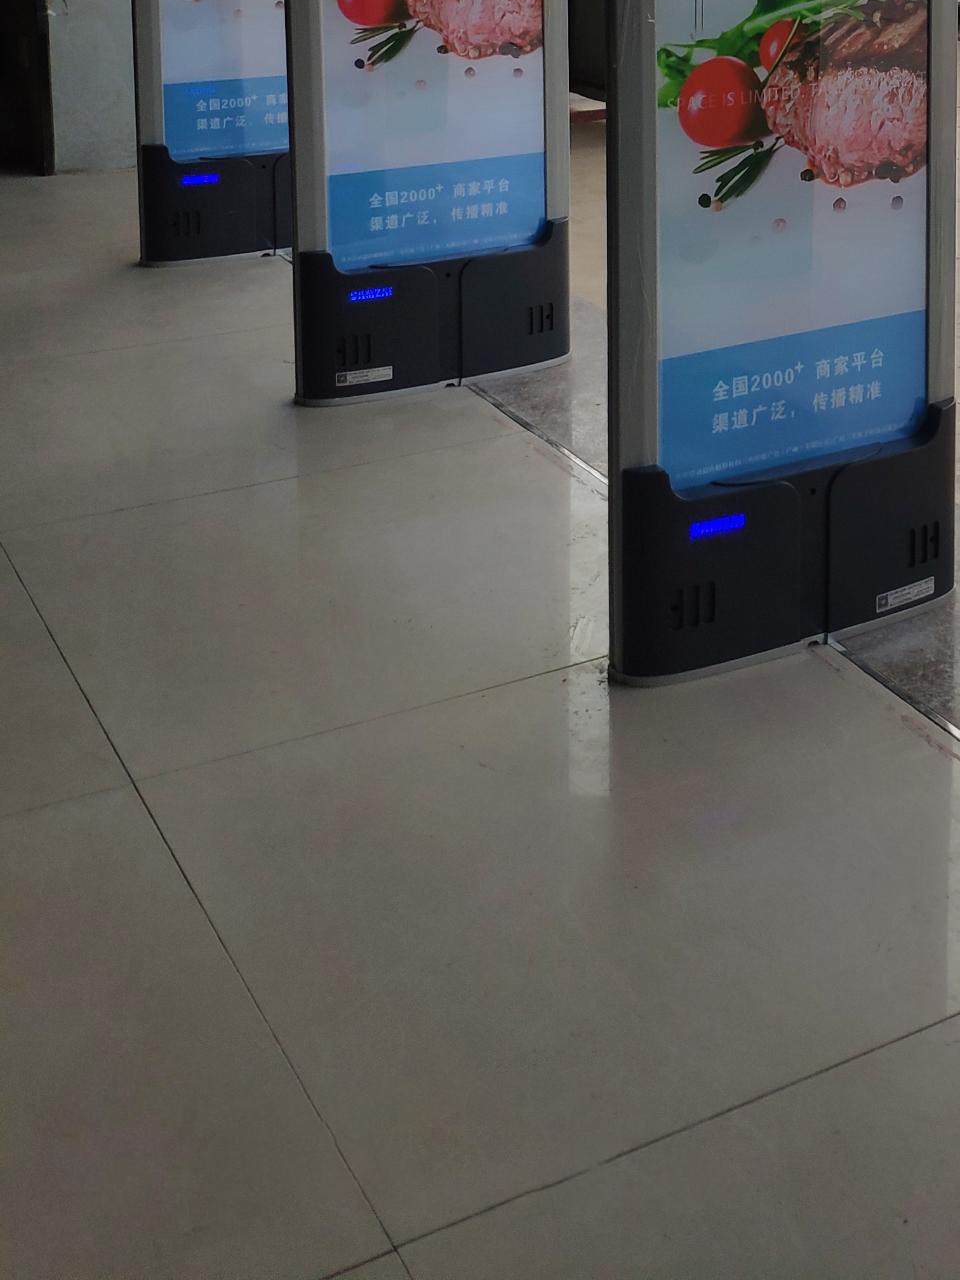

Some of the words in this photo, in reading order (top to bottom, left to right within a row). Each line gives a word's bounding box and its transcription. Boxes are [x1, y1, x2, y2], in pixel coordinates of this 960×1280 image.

[368, 183, 444, 209] 全国2000+
[453, 178, 511, 199] 商家平台
[451, 201, 509, 222] 传播精准
[712, 361, 805, 403] 全国2000+
[815, 347, 886, 381] 商家平台
[812, 380, 883, 414] 传播精准
